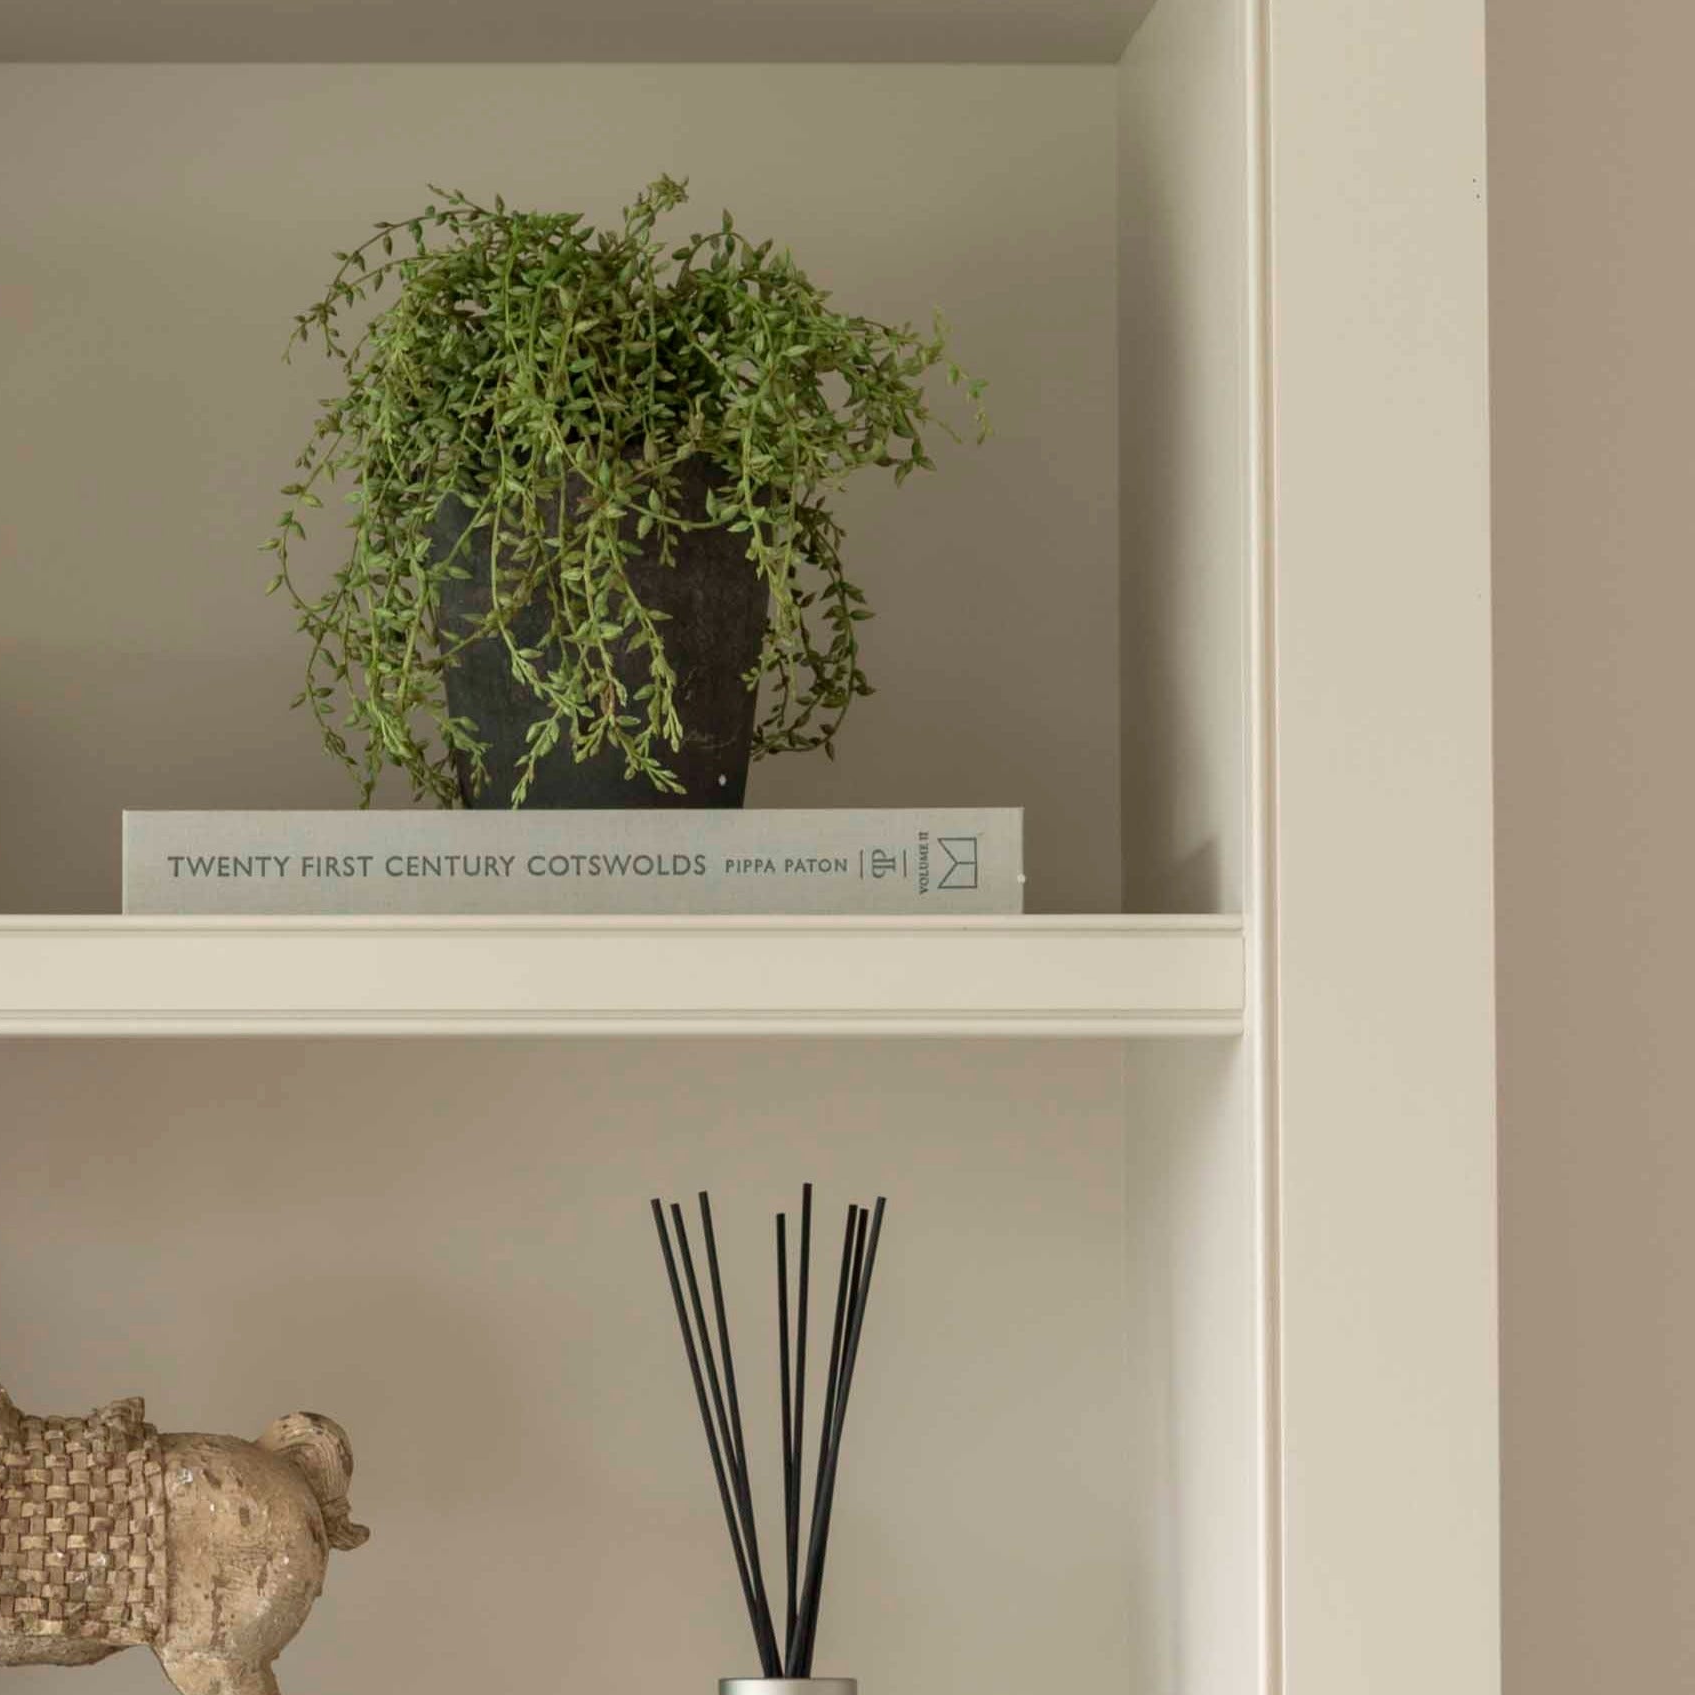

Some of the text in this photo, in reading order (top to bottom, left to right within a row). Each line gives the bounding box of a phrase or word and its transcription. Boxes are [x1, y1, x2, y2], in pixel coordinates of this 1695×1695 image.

[167, 854, 706, 878] TWENTY FIRST CENTURY COTSWOLDS
[725, 858, 848, 873] PIPPA PATON
[918, 831, 930, 895] VOLUME II
